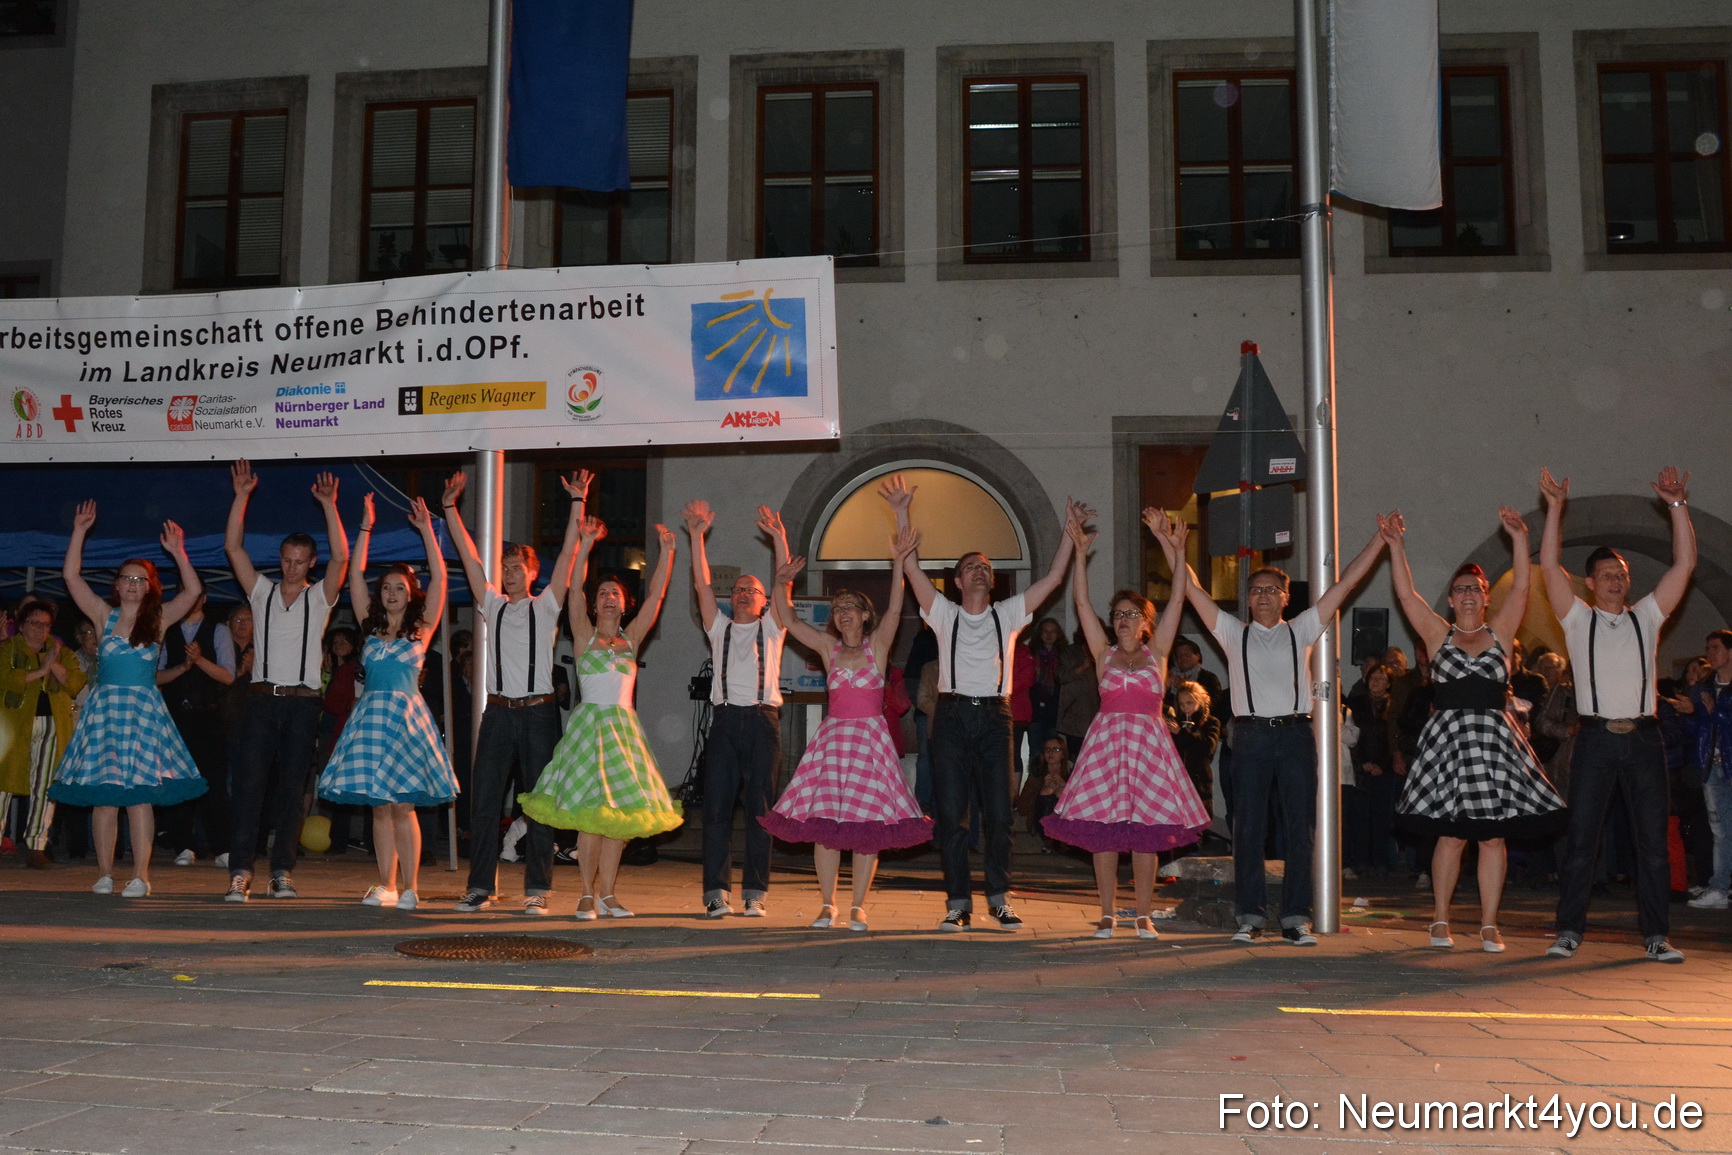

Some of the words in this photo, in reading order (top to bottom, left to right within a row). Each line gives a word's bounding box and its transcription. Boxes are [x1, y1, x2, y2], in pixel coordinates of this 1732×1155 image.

[0, 318, 263, 355] rbeitsgemeinschaft
[275, 315, 364, 341] offene
[376, 293, 645, 331] Behindertenarbeit
[79, 361, 112, 382] im
[123, 355, 260, 382] Landkreis
[270, 340, 405, 375] Neumarkt
[417, 334, 529, 363] i.d.OPf.
[275, 383, 332, 397] Diakonie
[89, 394, 164, 407] Bayerisches
[198, 394, 237, 404] Caritas-
[275, 401, 350, 413] Nürnberger
[353, 398, 385, 410] Land
[428, 391, 477, 410] Regens
[481, 388, 537, 407] Wagner
[90, 407, 123, 419] Rotes
[195, 404, 257, 416] Sozialstation
[92, 421, 126, 433] Kreuz
[195, 418, 244, 430] Neumarkt
[246, 417, 266, 429] e.V.
[275, 415, 339, 429] Neumarkt
